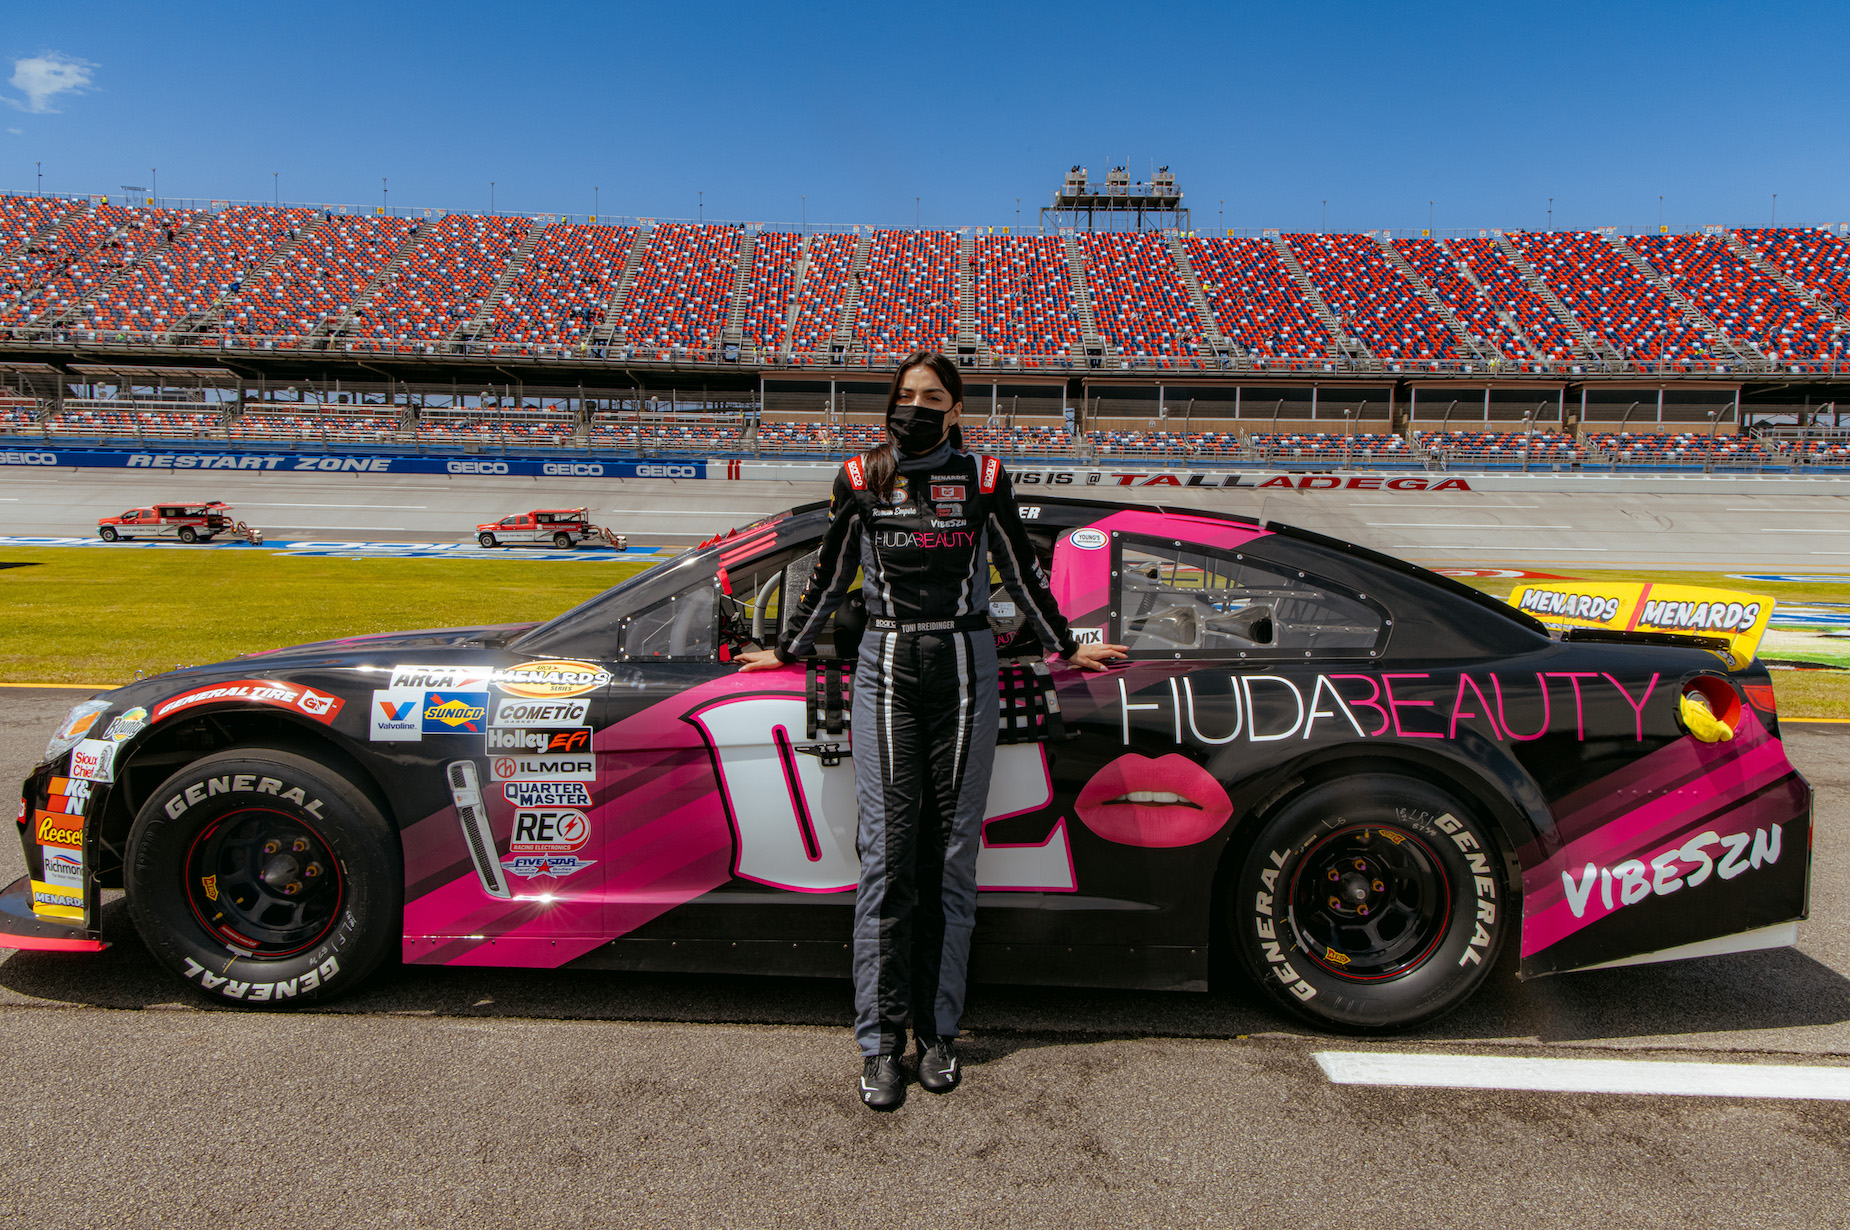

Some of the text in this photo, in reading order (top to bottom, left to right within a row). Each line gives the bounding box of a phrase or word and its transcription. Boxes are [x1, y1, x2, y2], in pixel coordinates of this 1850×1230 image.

[127, 455, 392, 472] RESTART ZONE
[447, 461, 509, 474] GEICO
[543, 463, 604, 476] GEICO
[636, 464, 696, 477] GEICO
[983, 459, 997, 488] sparco
[1045, 473, 1073, 484] IS
[1111, 473, 1472, 491] TALLADEGA
[1518, 588, 1620, 621] MENARDS
[1640, 599, 1761, 632] MENARDS
[876, 619, 897, 629] sparc
[902, 621, 955, 633] TONI BREIDINGER
[393, 668, 456, 688] ARCA
[490, 670, 611, 686] MENARDS
[158, 687, 299, 716] GENERAL TIRE
[428, 708, 484, 719] SUNOCO
[500, 705, 584, 720] COMETIC
[378, 722, 416, 730] Valvoline
[488, 730, 549, 753] Holley
[74, 752, 98, 765] Sioux
[73, 765, 94, 778] Chief
[520, 762, 592, 773] ILMOR
[164, 774, 324, 821] GENERAL
[506, 783, 583, 799] QUARTER
[520, 794, 588, 806] MASTER
[38, 816, 83, 846] Reese's
[515, 858, 576, 867] FIVE STAR
[1561, 823, 1782, 918] VIBESZN
[1434, 812, 1496, 967] GENERAL
[1256, 848, 1318, 1002] GENERAL
[183, 956, 341, 1001] GENERAL
